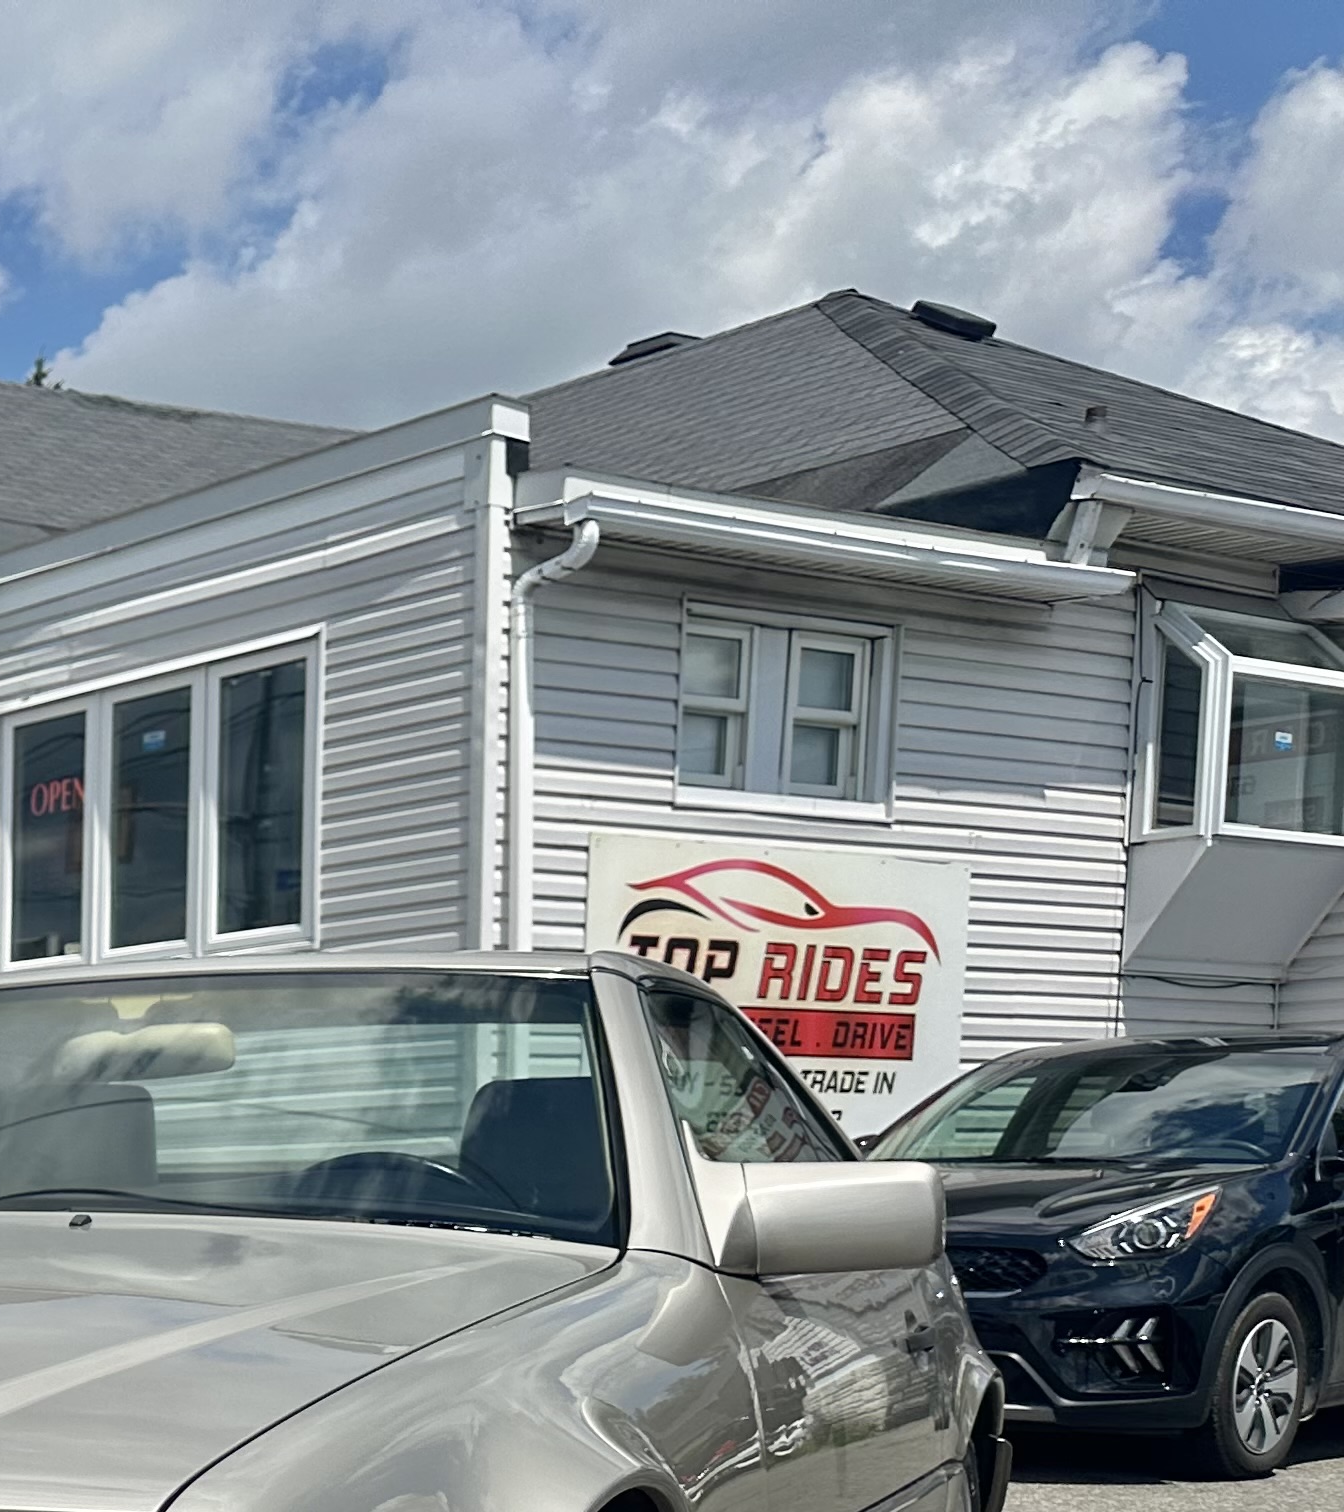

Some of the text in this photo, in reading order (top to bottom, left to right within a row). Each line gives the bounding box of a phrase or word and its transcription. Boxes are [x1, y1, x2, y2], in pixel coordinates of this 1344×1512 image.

[30, 777, 84, 817] OPEN
[629, 934, 928, 1006] TOP RIDES
[831, 1021, 912, 1051] DRIVE
[800, 1069, 870, 1094] TRADE
[873, 1070, 897, 1095] IN
